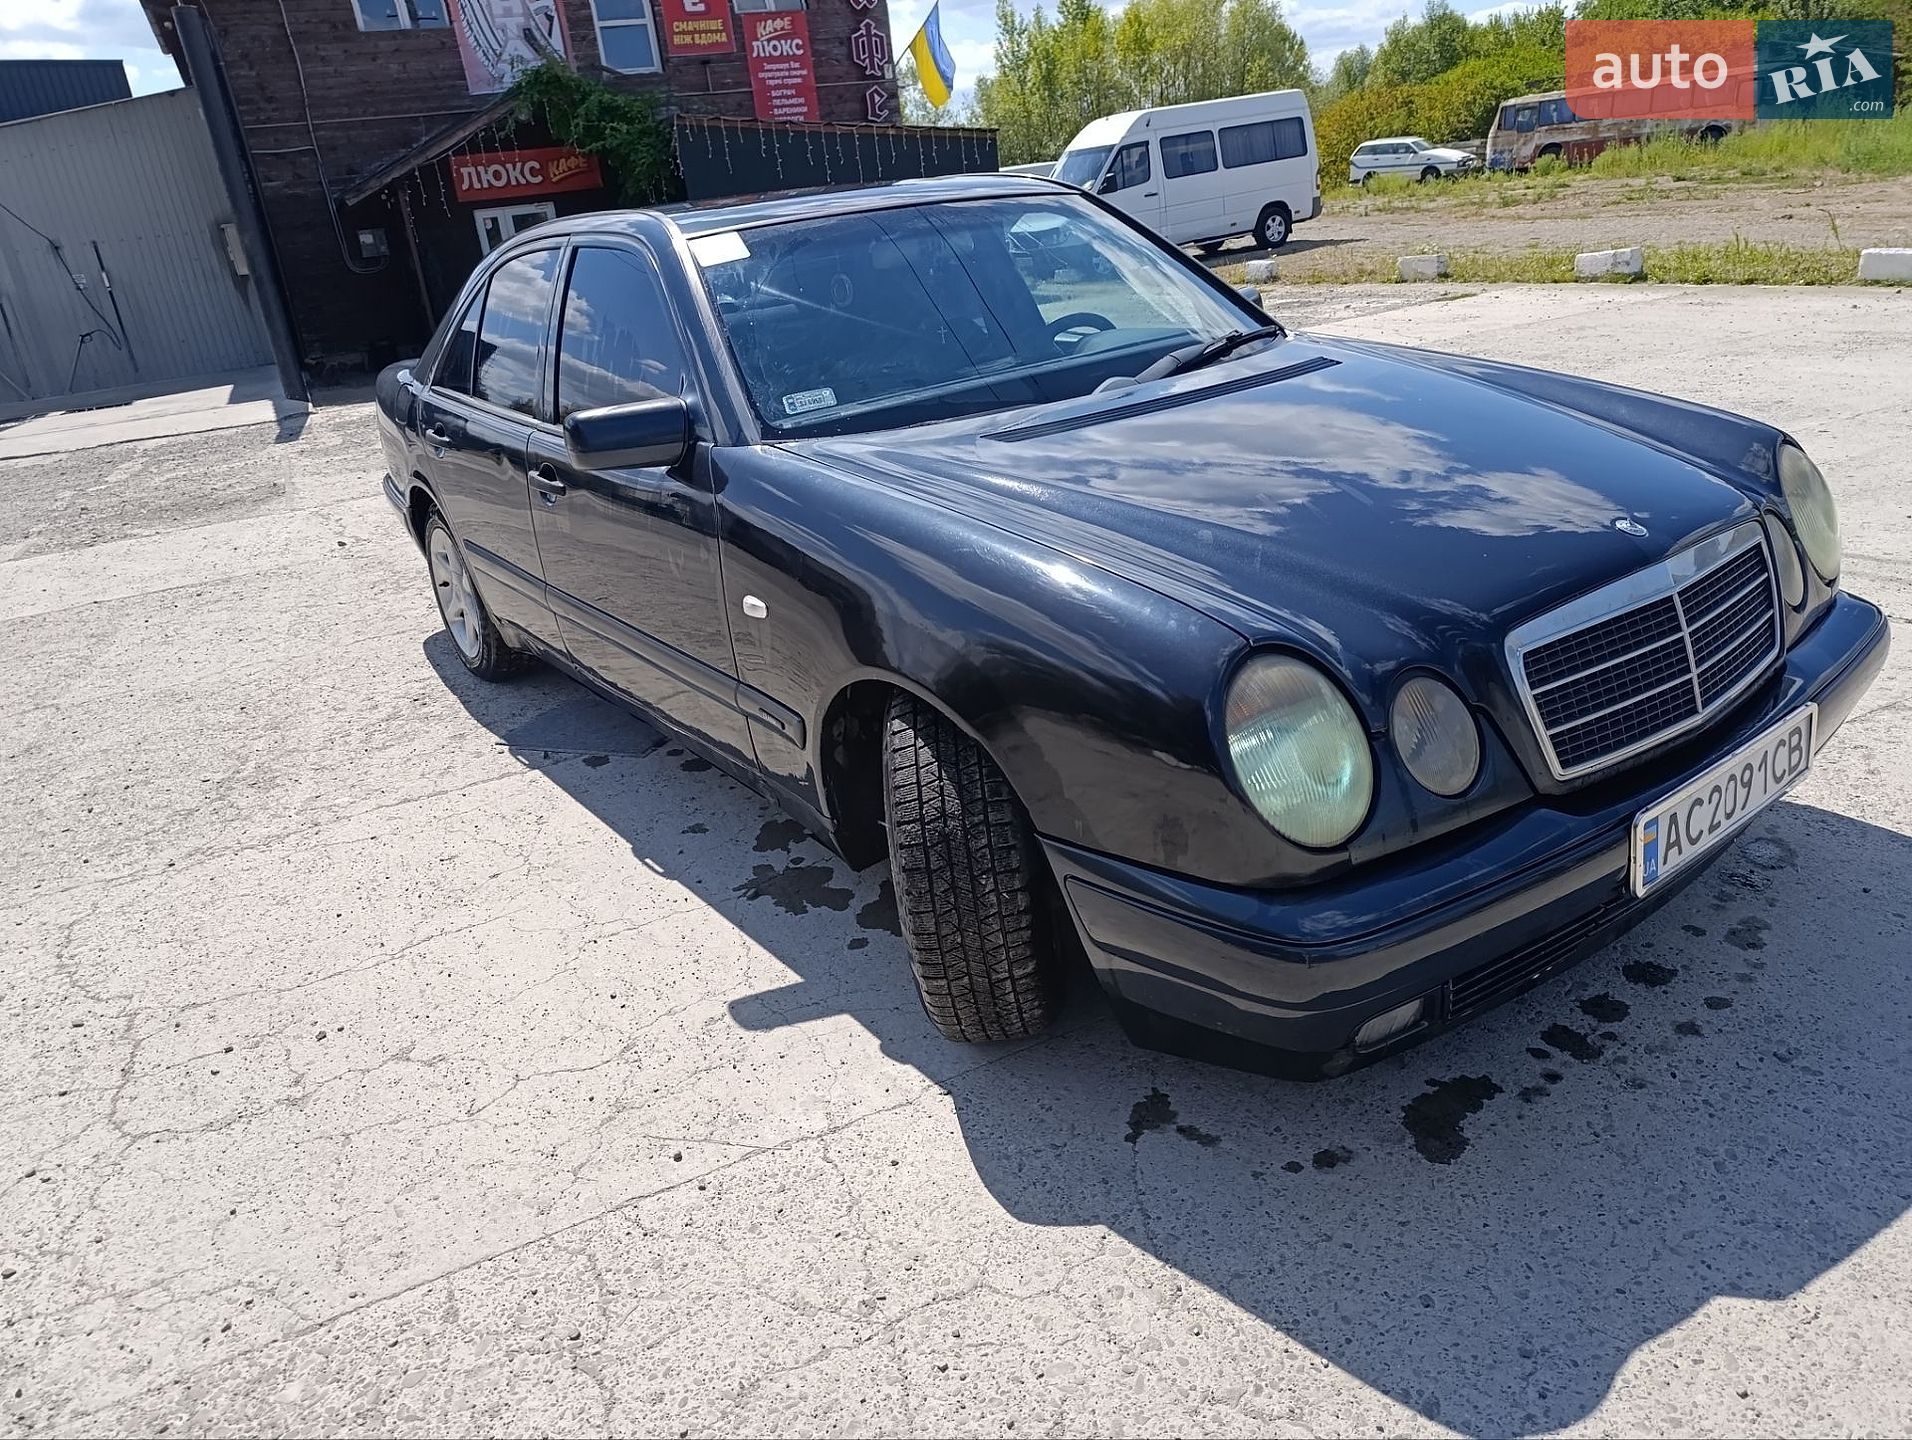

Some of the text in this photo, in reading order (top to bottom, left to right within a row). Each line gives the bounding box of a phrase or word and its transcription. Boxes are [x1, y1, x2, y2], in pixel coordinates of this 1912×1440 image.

[673, 19, 724, 32] СМАЧНІШЕ
[757, 16, 793, 38] КАФЕ
[673, 32, 728, 45] НІЖ ВДОМА
[752, 38, 804, 57] ЛЮКС
[461, 156, 588, 190] ЛЮКС КАФЕ
[1663, 726, 1803, 866] AC2091CB
